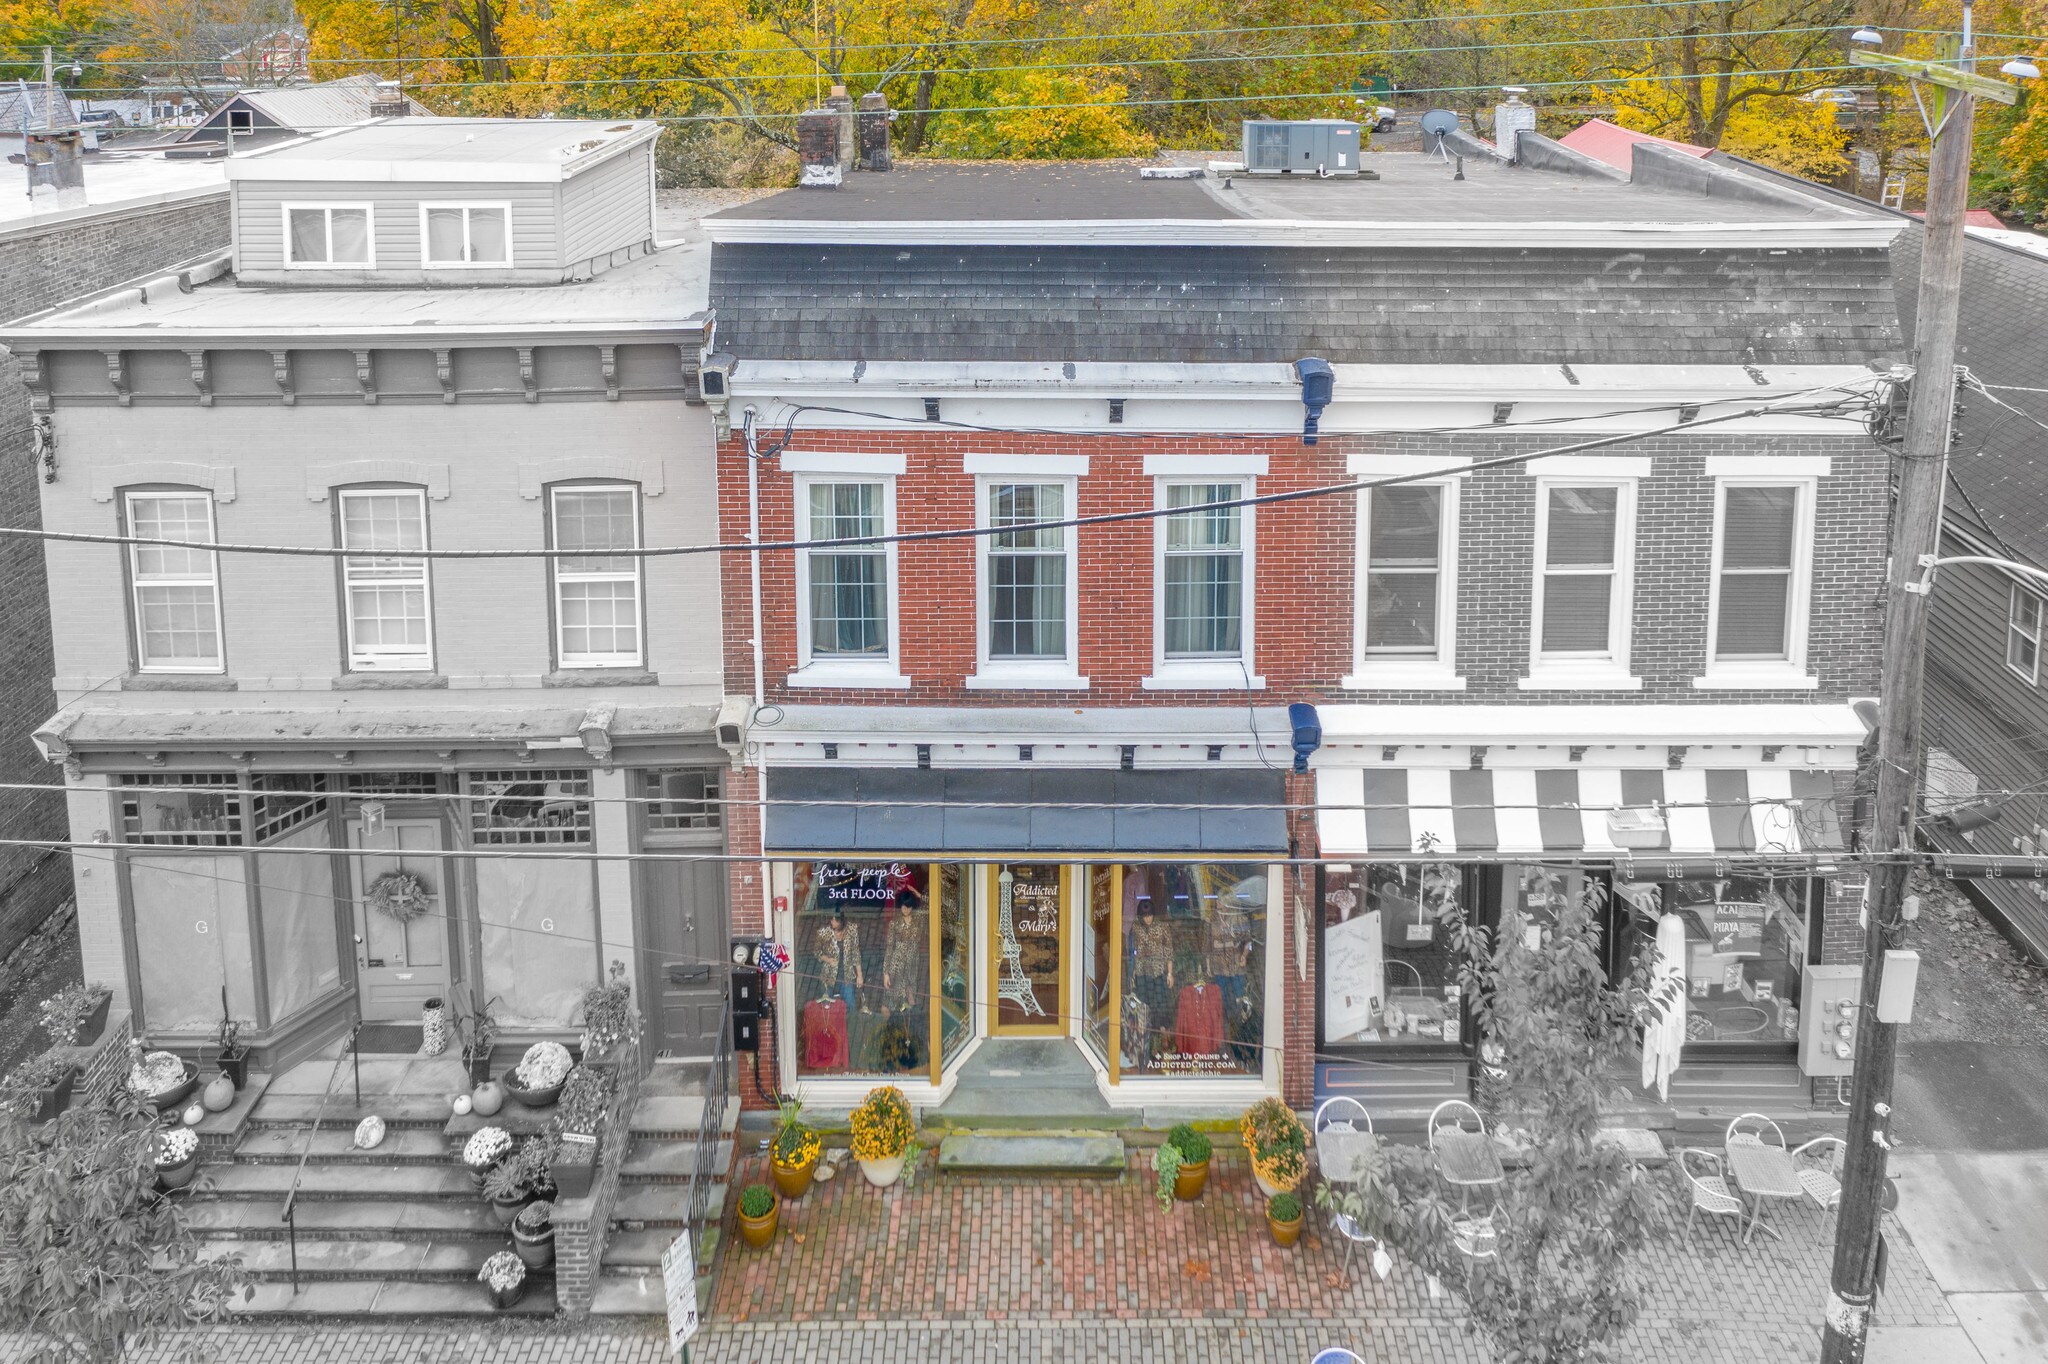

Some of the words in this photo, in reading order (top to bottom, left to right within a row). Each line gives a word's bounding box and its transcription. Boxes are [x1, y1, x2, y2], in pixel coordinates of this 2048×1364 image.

[811, 863, 852, 886] free
[857, 863, 912, 888] people
[828, 888, 848, 899] 3rd
[851, 889, 895, 900] FLOOR
[1013, 883, 1058, 896] Addicted
[1716, 905, 1738, 915] ACAI
[195, 920, 208, 934] G
[541, 918, 554, 932] G
[1018, 920, 1057, 935] Mary's
[1713, 922, 1740, 933] PITAYA
[663, 1252, 671, 1270] 2
